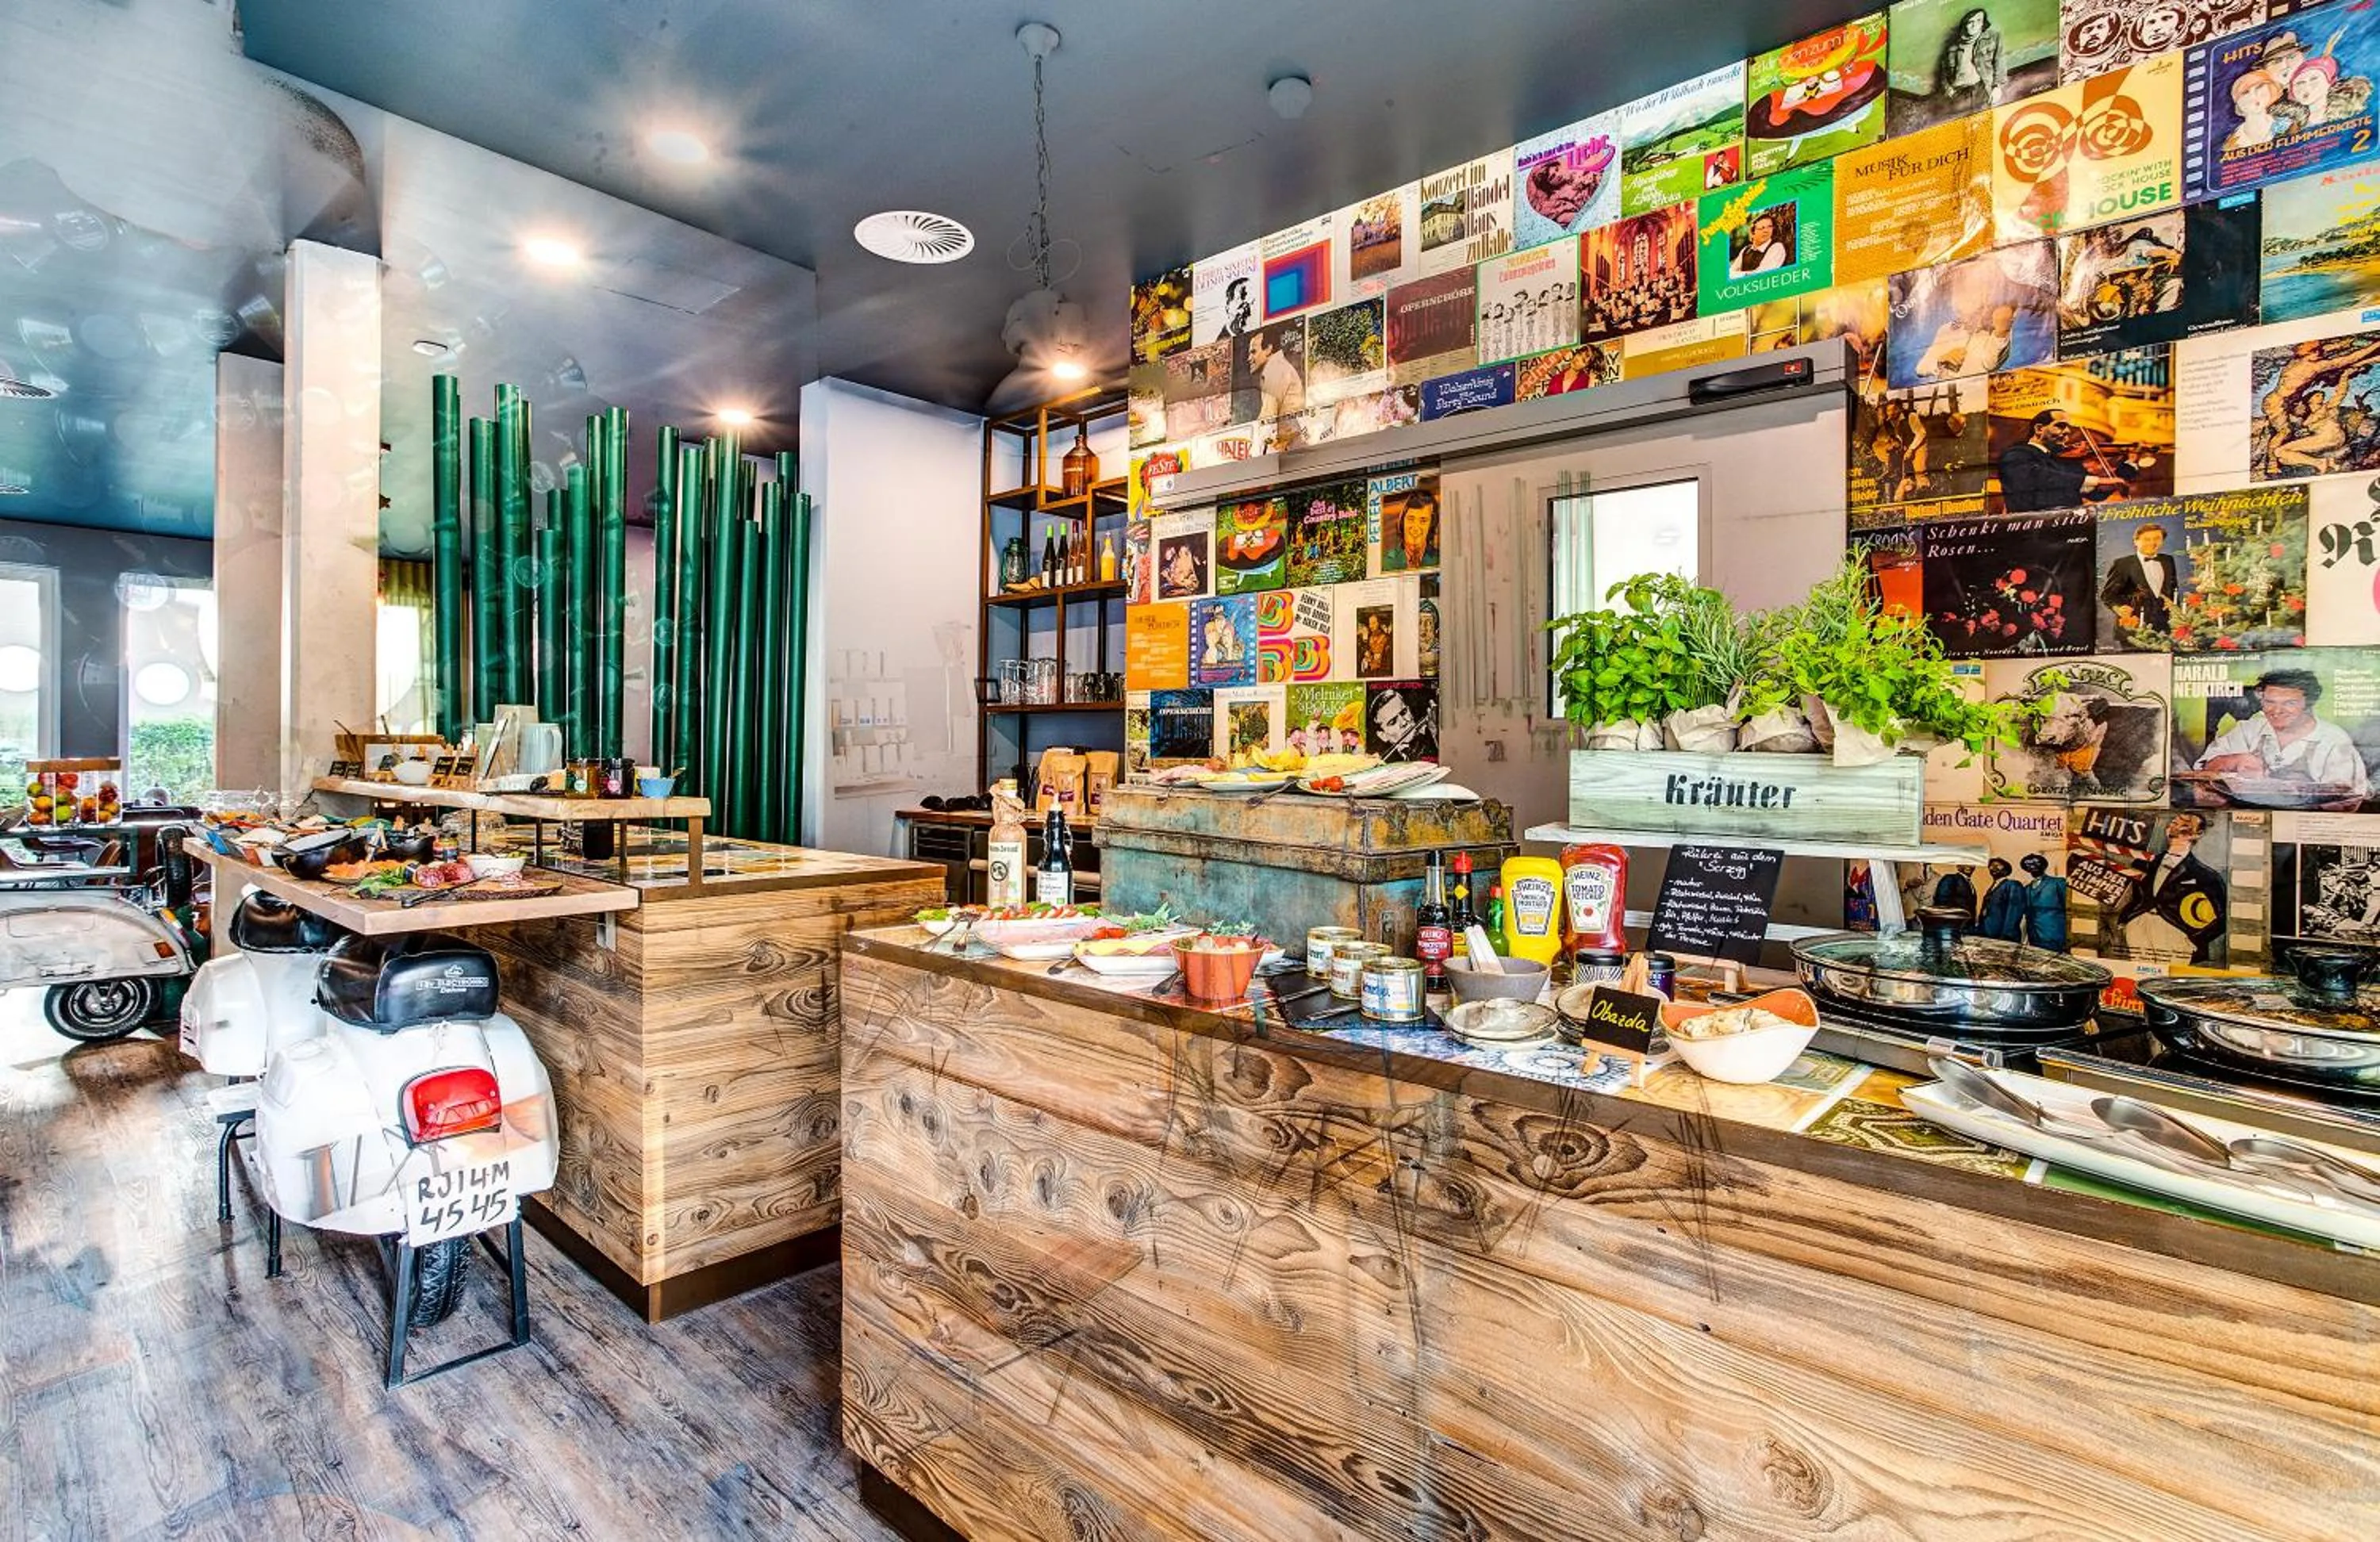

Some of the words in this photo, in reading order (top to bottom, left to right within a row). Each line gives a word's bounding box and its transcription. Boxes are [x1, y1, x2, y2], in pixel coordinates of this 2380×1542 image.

[2222, 42, 2264, 64] HITS
[2351, 128, 2370, 154] 2
[1855, 153, 1910, 178] MUSIK
[1926, 147, 1970, 171] DICH
[2097, 167, 2141, 186] OCKIN'
[1715, 268, 1811, 301] VOLKSLIEDER
[1368, 473, 1419, 494] ALBERT
[2102, 501, 2183, 521] Fröhliche
[2183, 490, 2306, 513] Weihnachten
[1368, 496, 1382, 543] PETER
[2174, 664, 2228, 682] HARALD
[2174, 681, 2244, 699] NEUKIRCH
[1665, 774, 1797, 808] Kräuter
[1954, 803, 1994, 828] Gate
[1997, 810, 2063, 832] Quartet
[2086, 811, 2147, 844] HITS
[1574, 872, 1602, 881] HEINZ
[2070, 869, 2125, 897] FLIMMER
[2077, 859, 2104, 876] AUS
[2104, 869, 2126, 886] DER
[1572, 884, 1605, 894] TOMATO
[1591, 1000, 1649, 1033] Obazda
